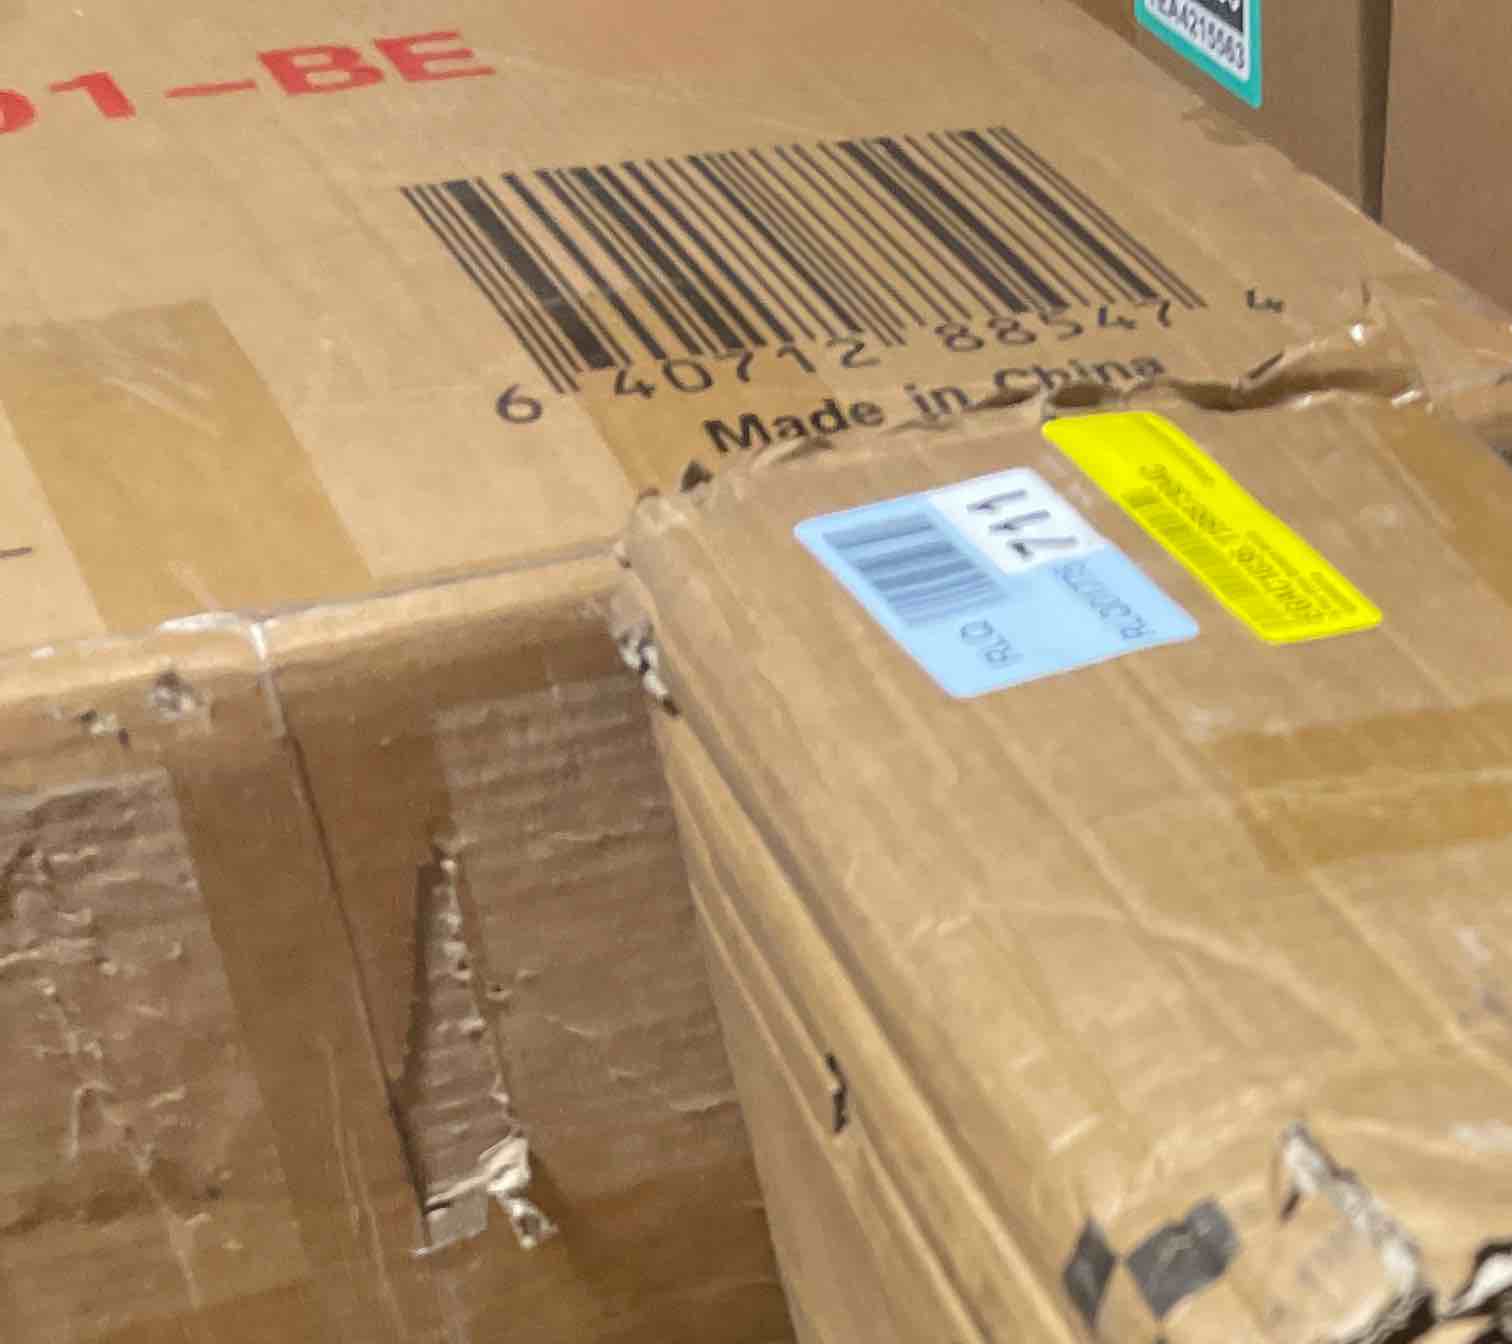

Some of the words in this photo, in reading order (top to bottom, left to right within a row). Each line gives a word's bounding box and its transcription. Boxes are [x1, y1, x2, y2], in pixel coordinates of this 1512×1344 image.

[495, 384, 543, 425] 6
[704, 404, 886, 457] Made
[906, 377, 967, 409] in
[993, 354, 1167, 395] China
[967, 489, 1077, 562] 711
